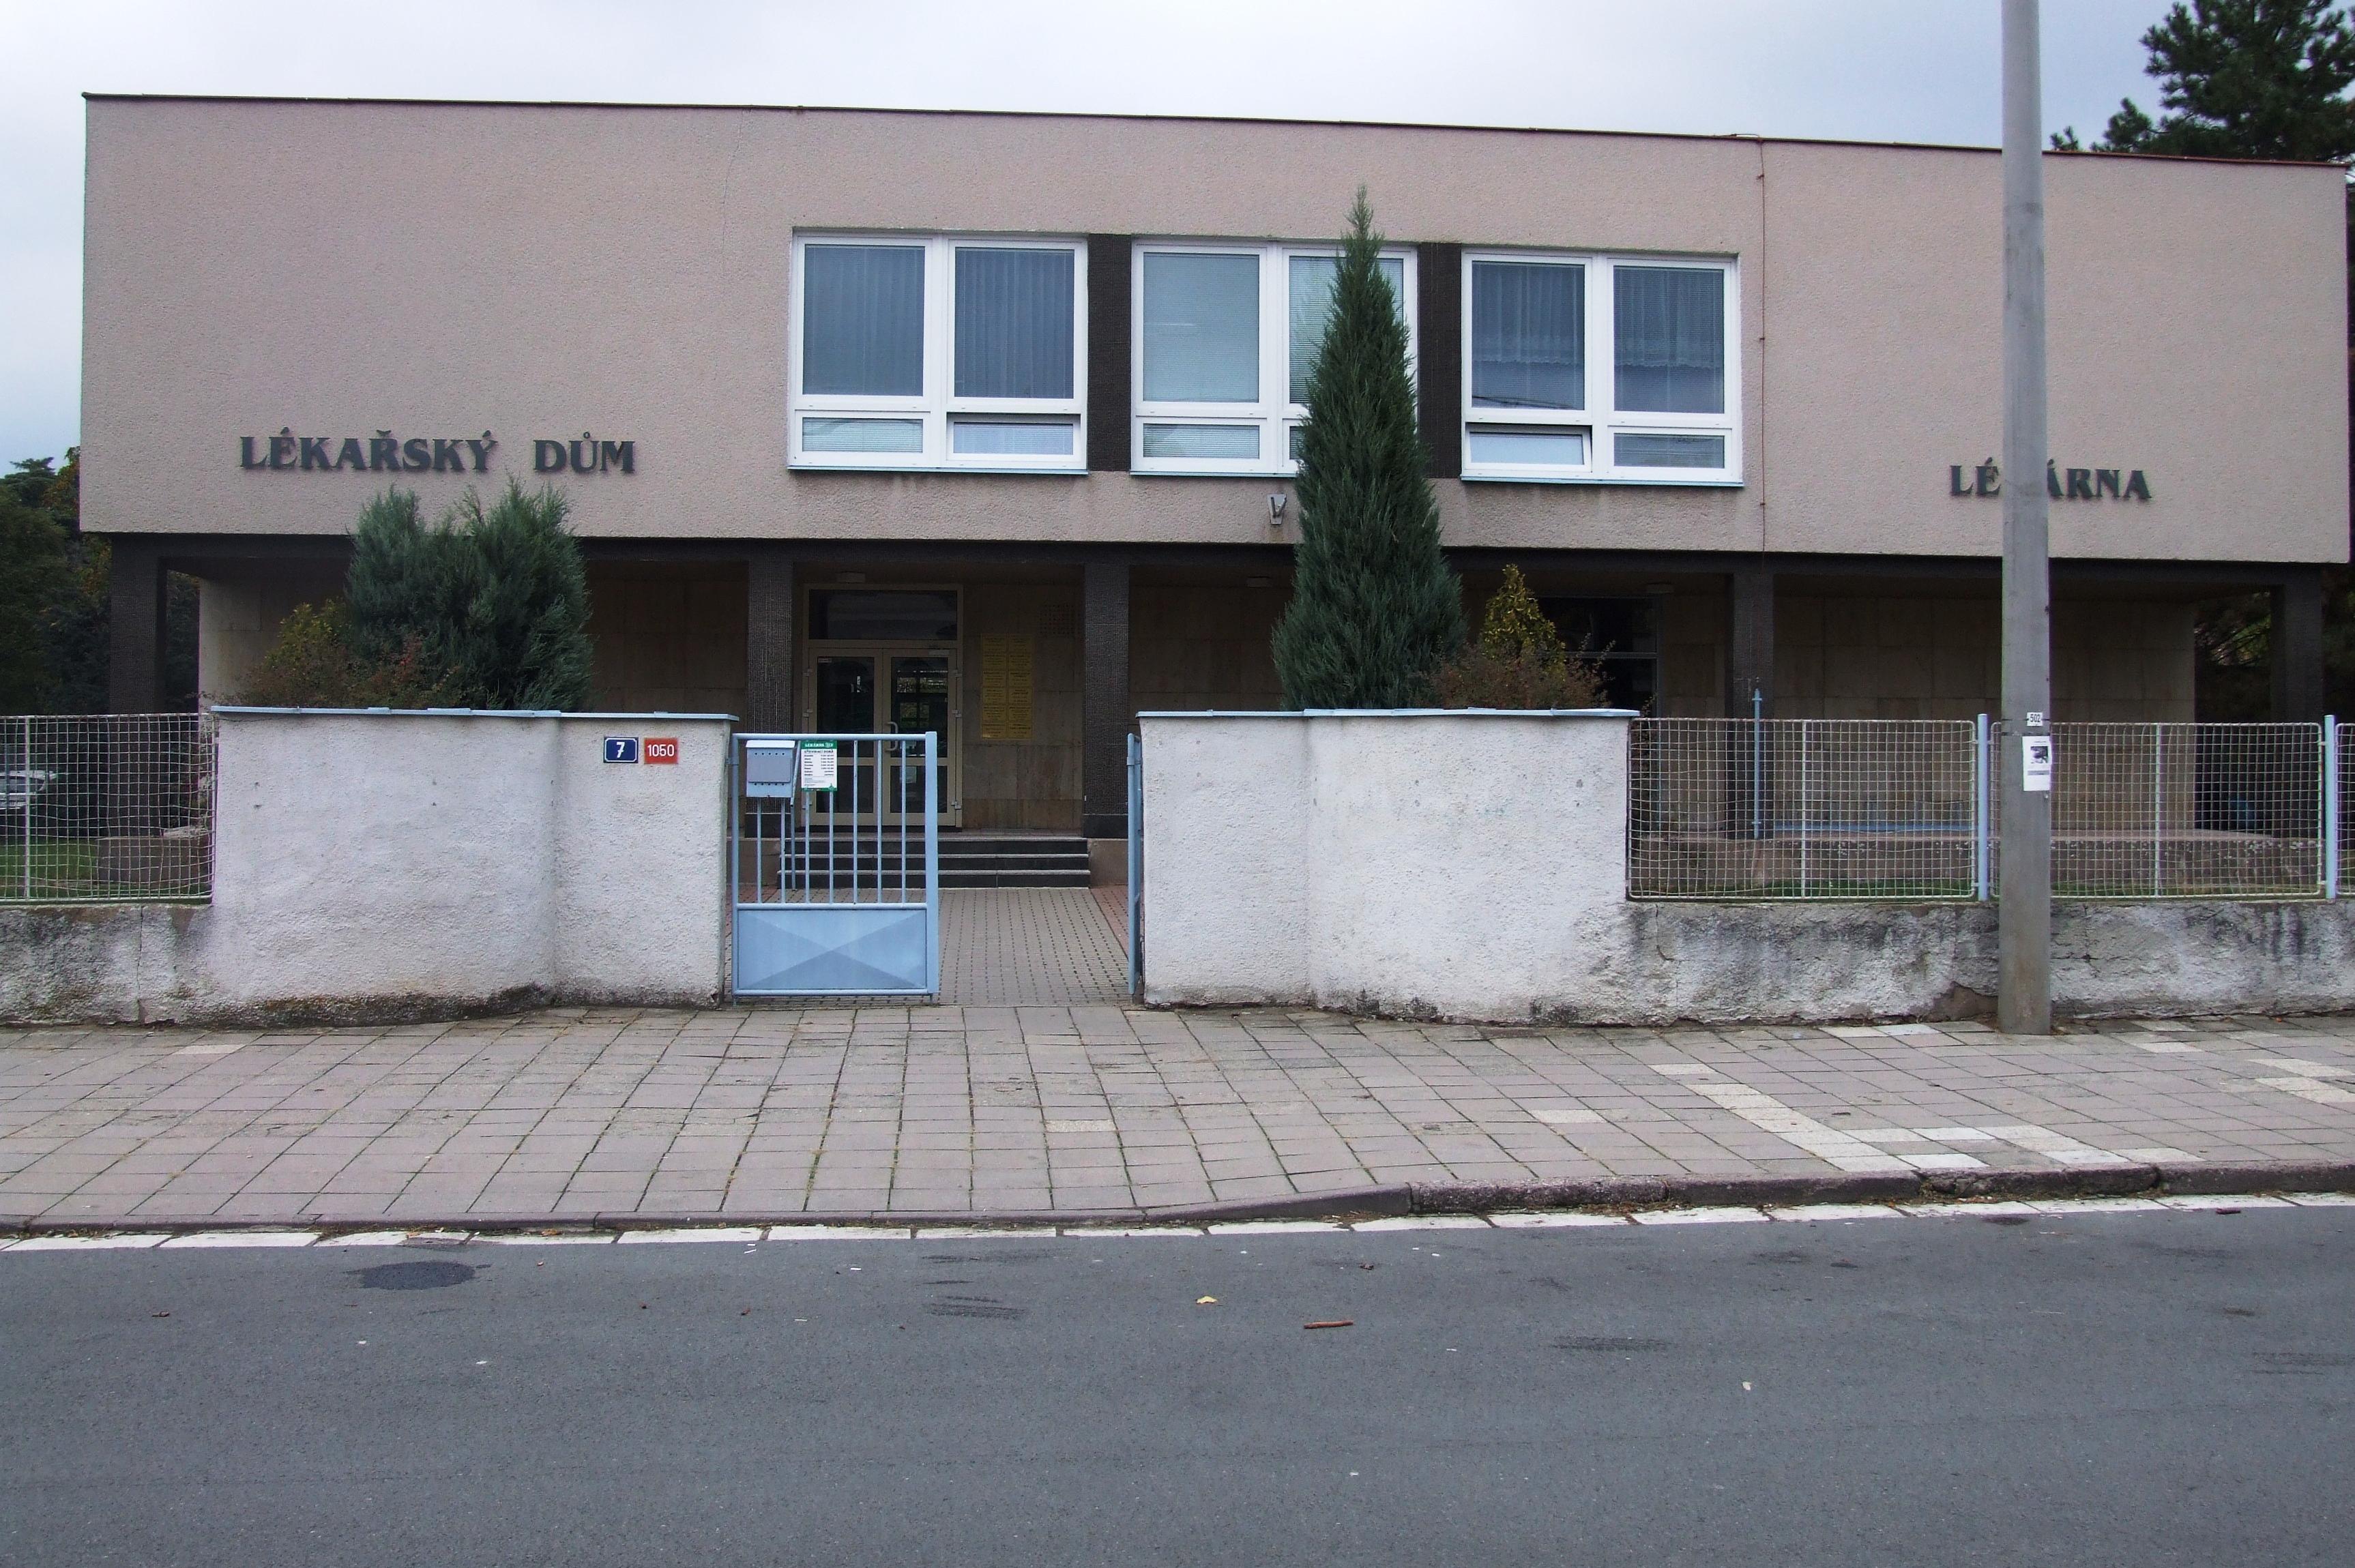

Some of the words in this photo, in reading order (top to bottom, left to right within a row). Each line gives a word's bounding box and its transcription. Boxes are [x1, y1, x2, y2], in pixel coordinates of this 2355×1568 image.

[240, 426, 498, 471] LÉKAŘSKÝ
[533, 431, 636, 473] DŮM
[1950, 456, 2152, 499] LÉÁRNA
[2030, 713, 2040, 723] 502
[616, 741, 625, 758] 7
[647, 744, 675, 757] 1050
